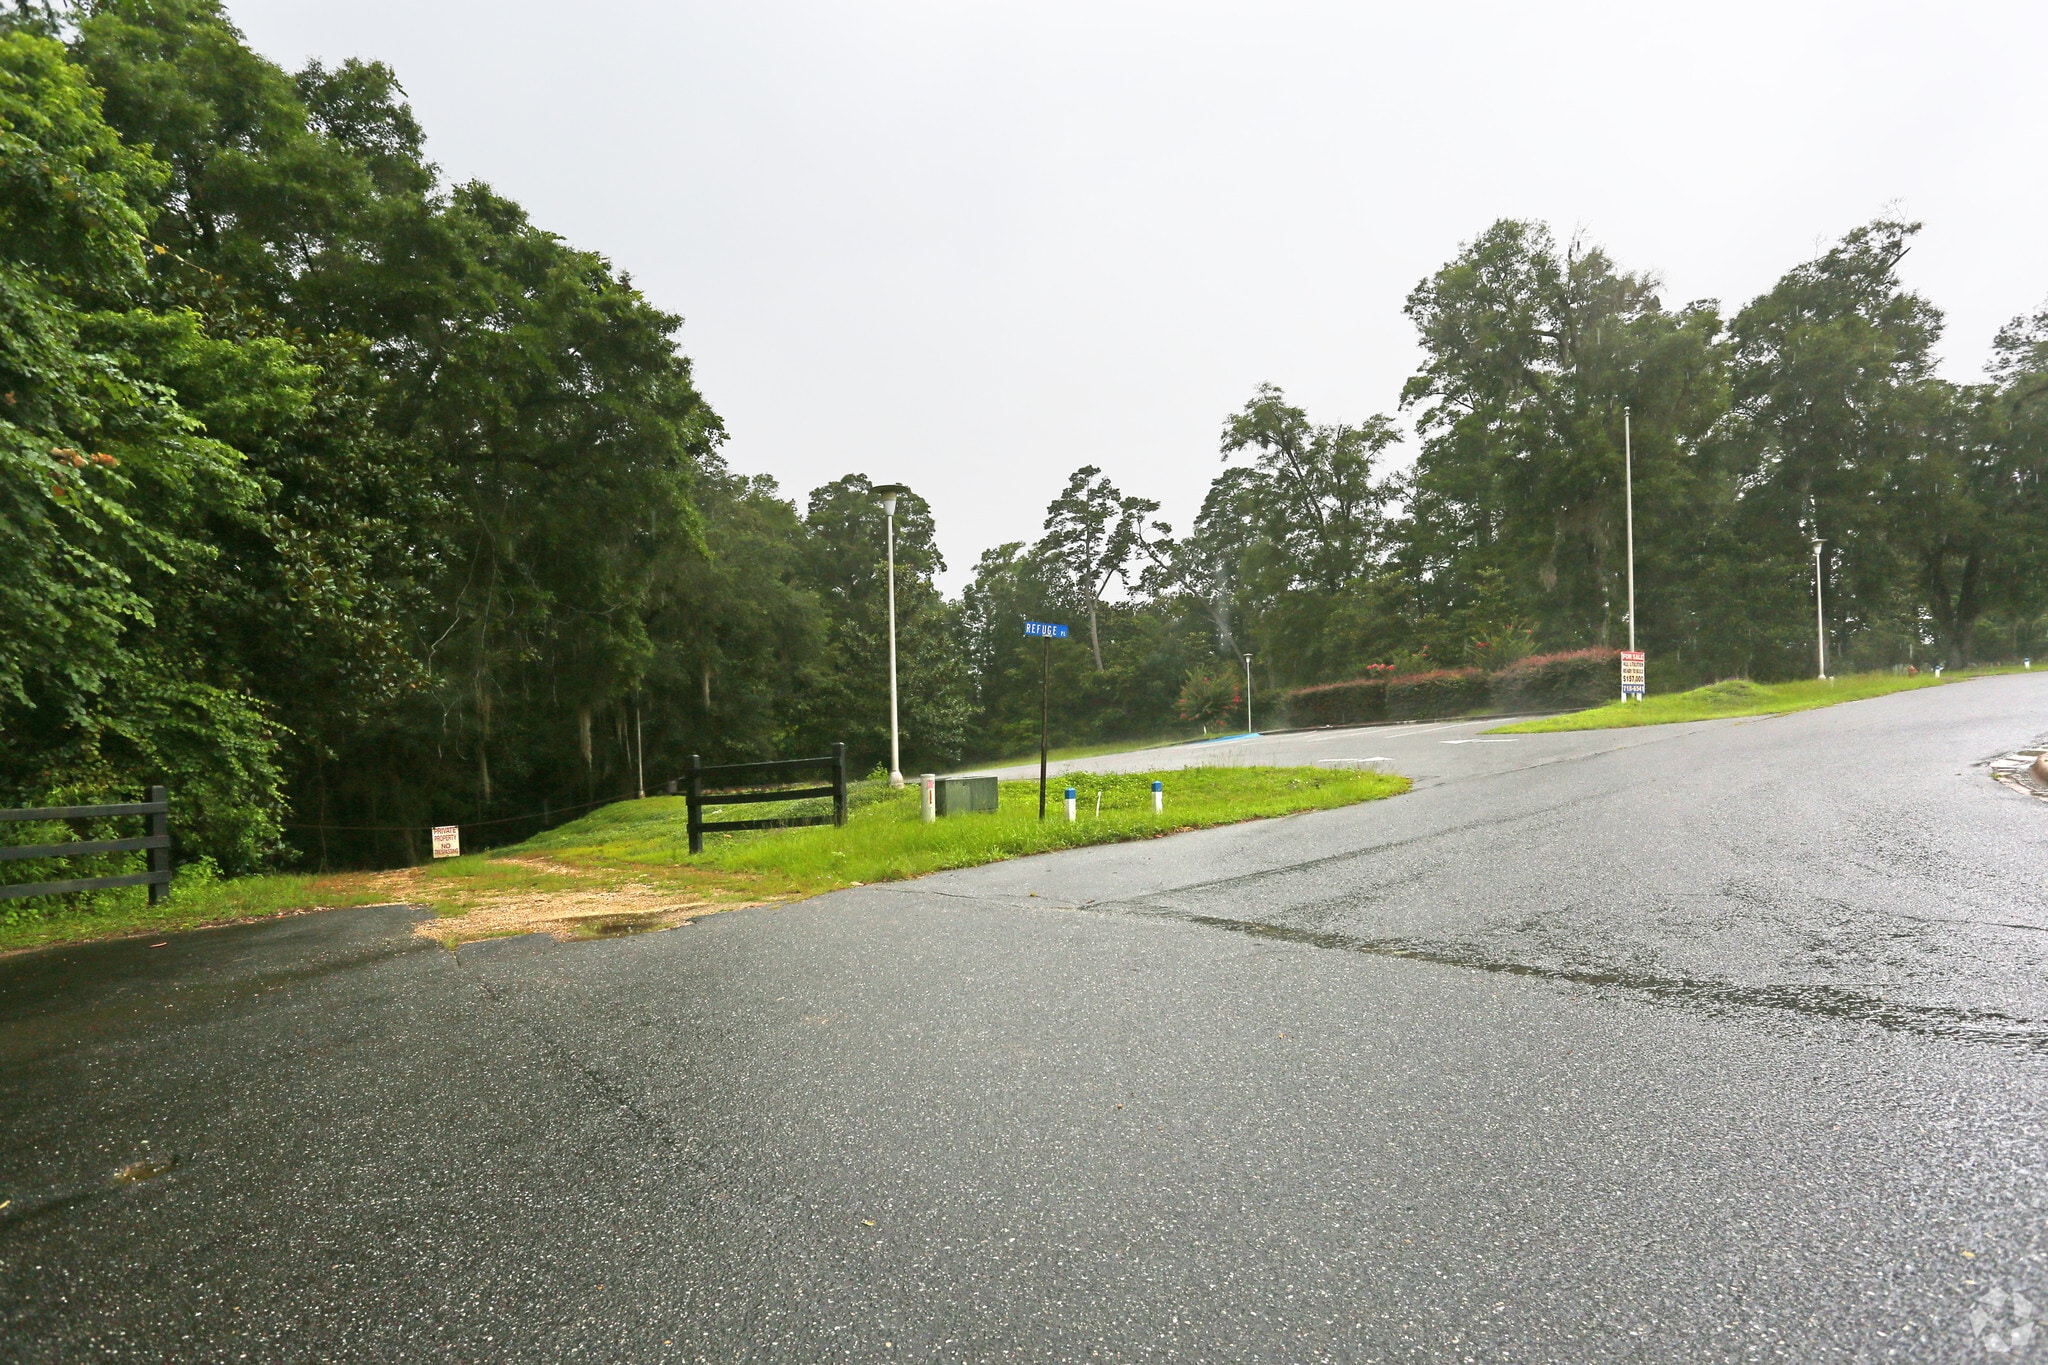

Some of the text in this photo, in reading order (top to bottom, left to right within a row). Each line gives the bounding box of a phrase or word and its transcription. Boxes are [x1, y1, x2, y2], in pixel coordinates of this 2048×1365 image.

[1026, 623, 1057, 636] REFUGE
[1633, 653, 1644, 661] SALE
[434, 834, 457, 842] PROPERTY
